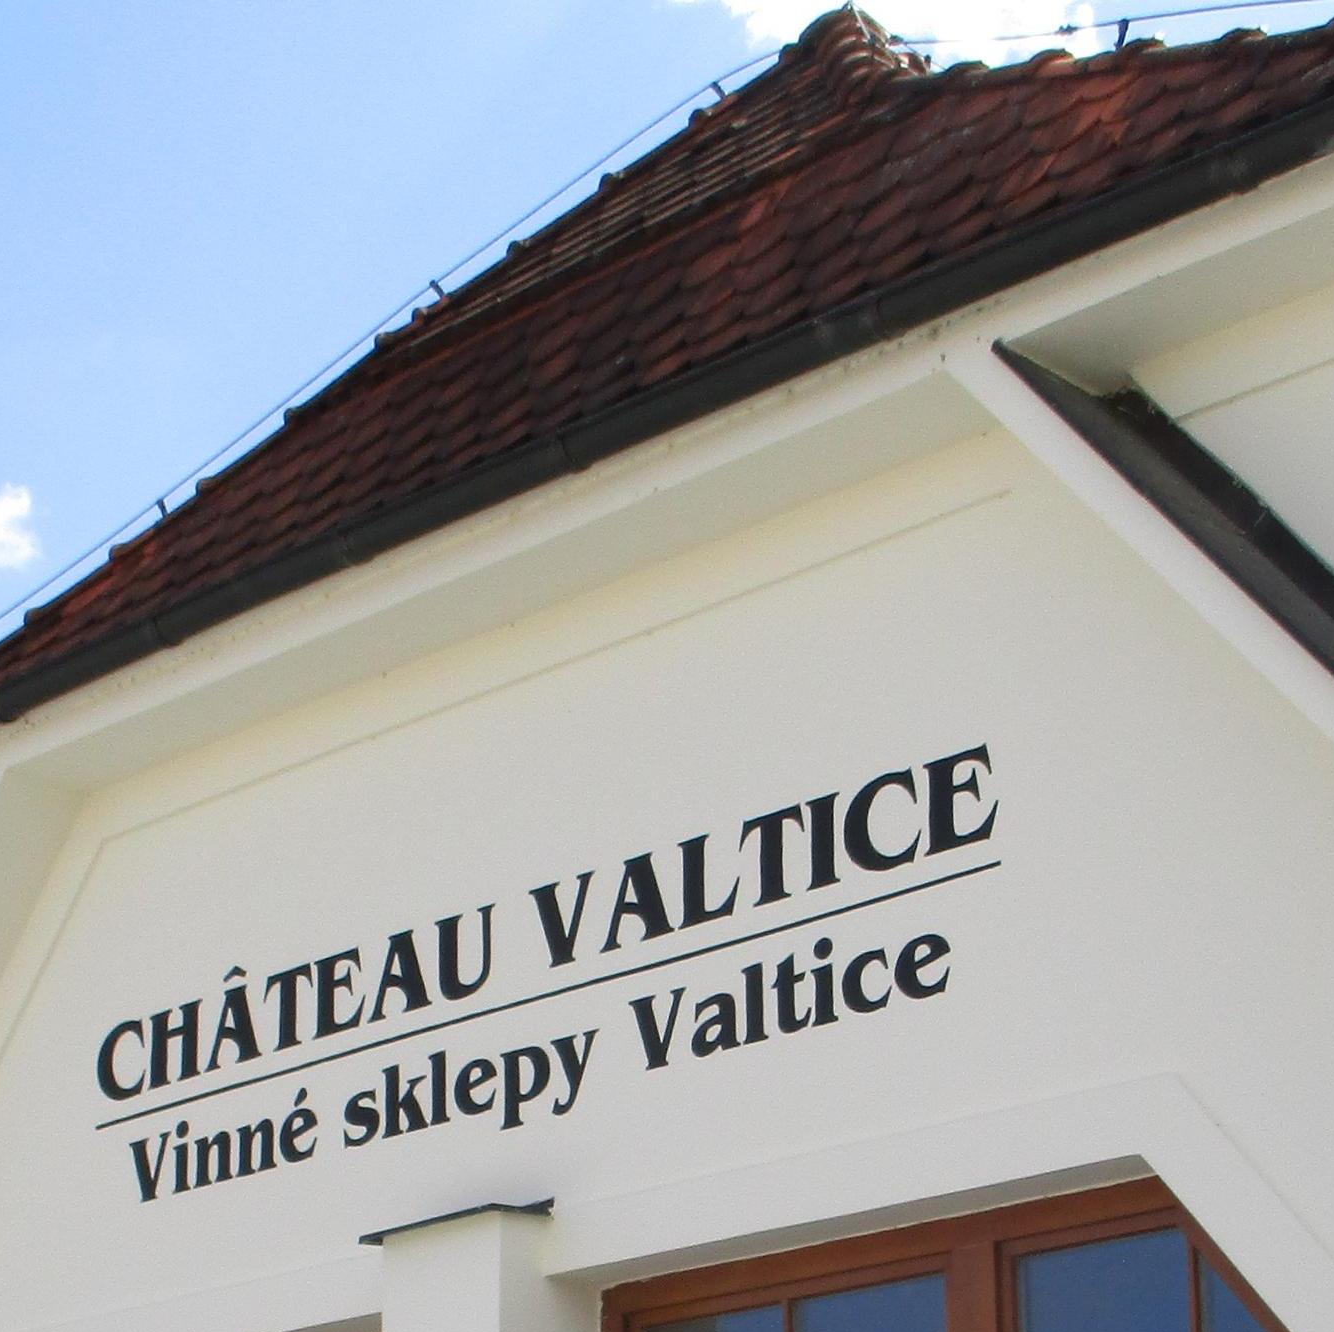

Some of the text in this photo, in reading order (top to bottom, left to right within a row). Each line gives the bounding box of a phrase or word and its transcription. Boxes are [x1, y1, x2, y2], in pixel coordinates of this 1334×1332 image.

[96, 743, 999, 1101] CHÂTEAU VALTICE
[130, 933, 951, 1202] Vinné sklepy Valtice
